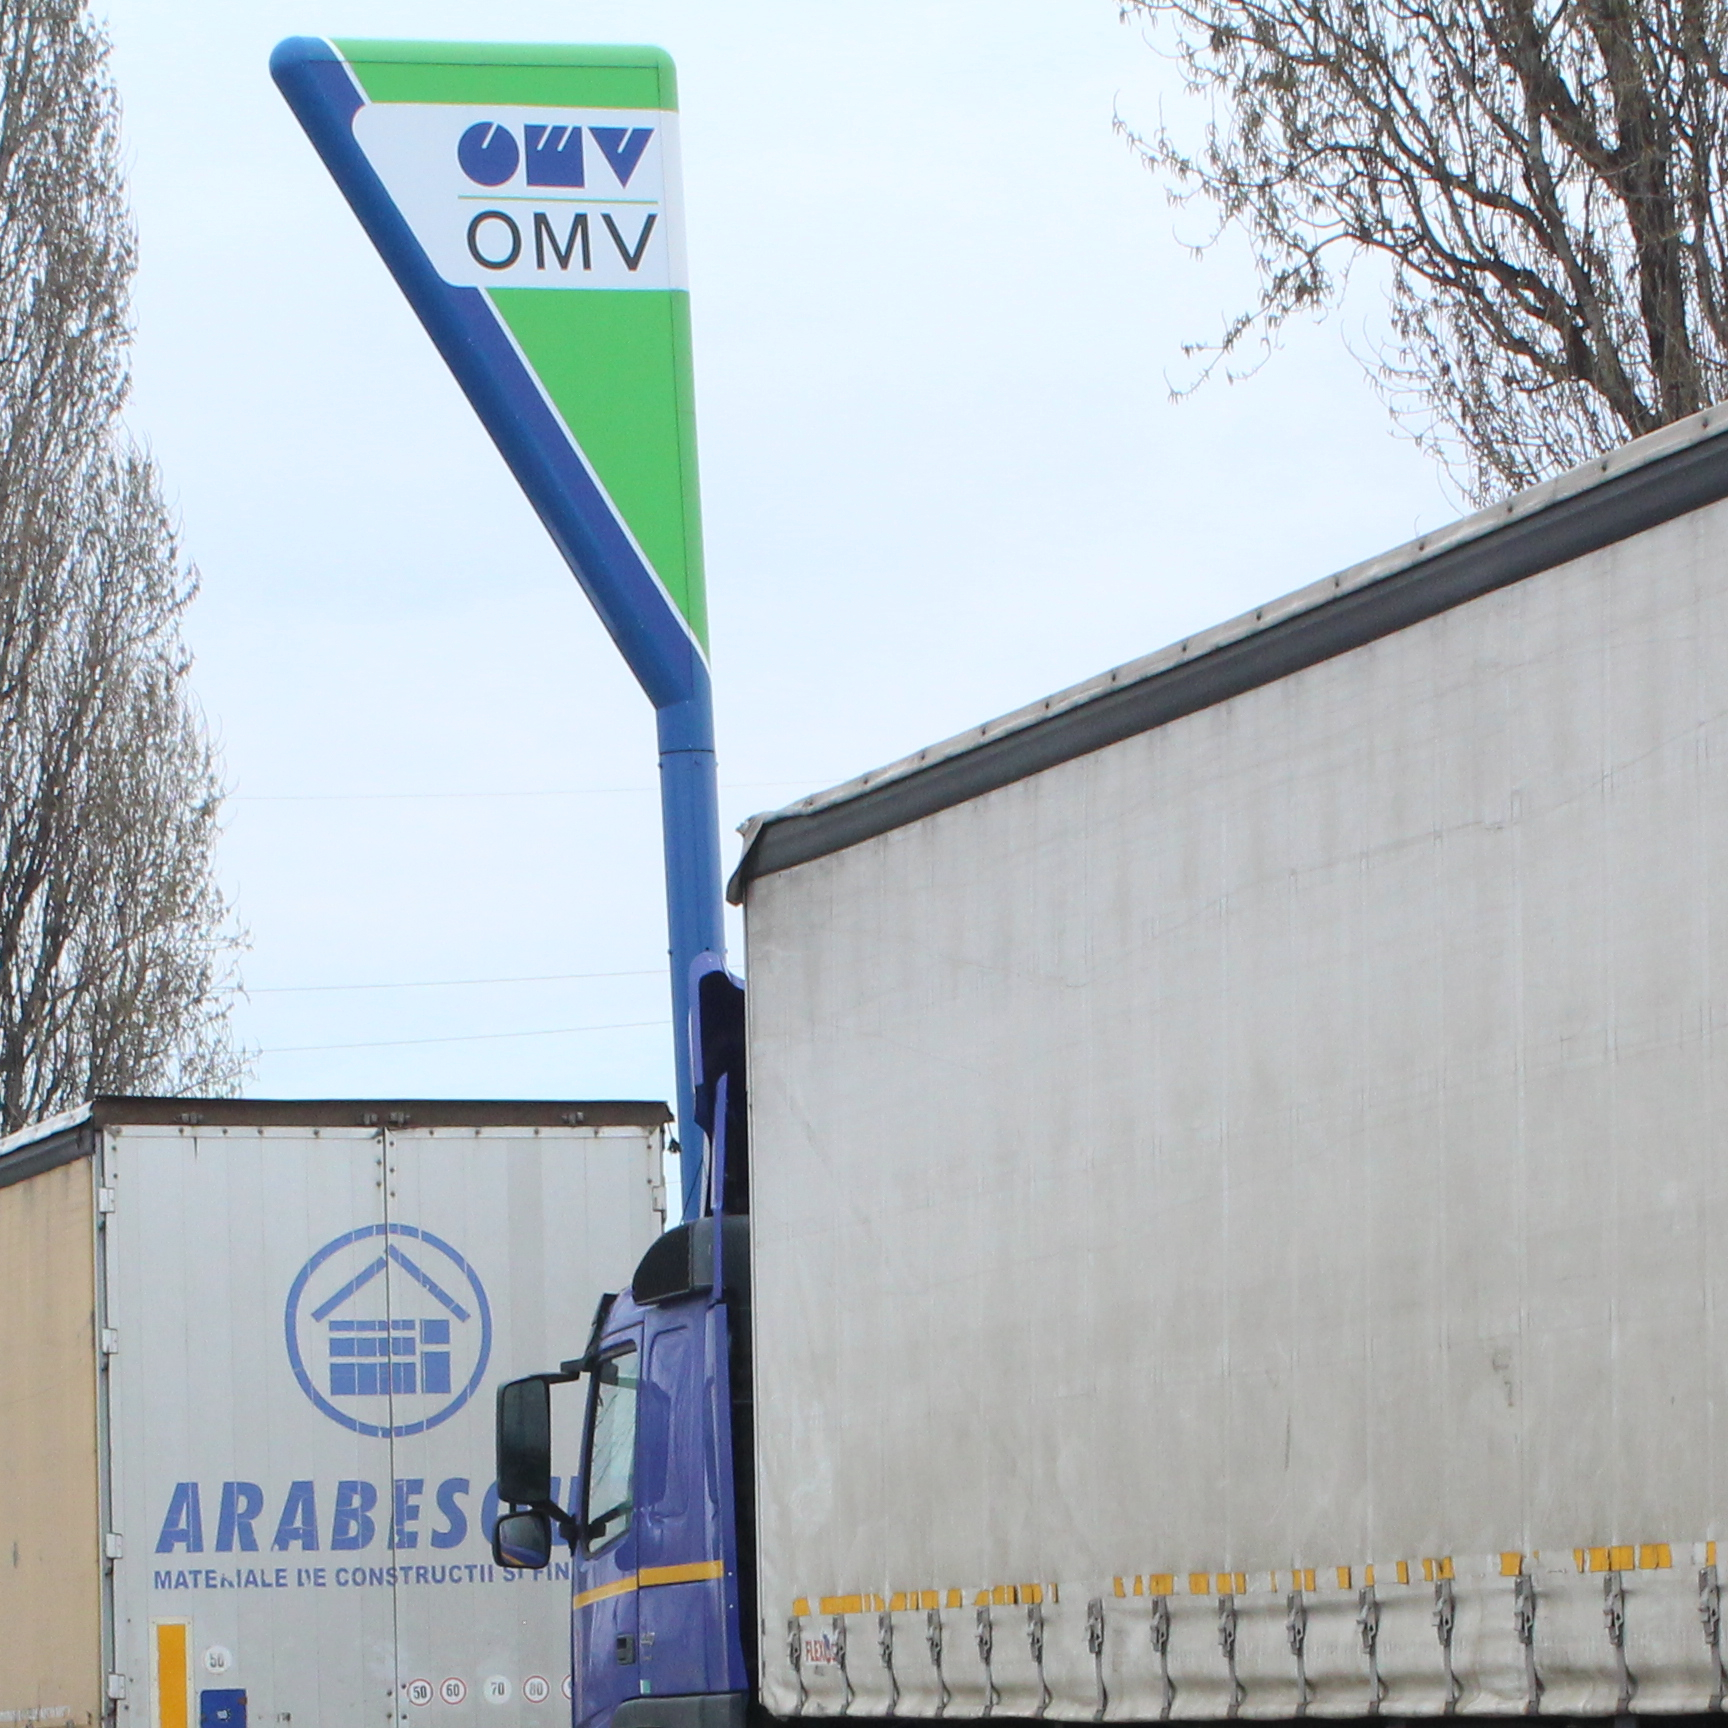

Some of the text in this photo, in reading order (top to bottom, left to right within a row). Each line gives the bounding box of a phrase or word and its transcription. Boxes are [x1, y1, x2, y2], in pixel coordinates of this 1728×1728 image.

[466, 210, 658, 271] OMV
[155, 1475, 579, 1553] ARABESU
[297, 1567, 327, 1588] DE
[335, 1563, 494, 1587] CONSTRUCTII
[533, 1561, 570, 1582] FIN
[413, 1685, 427, 1700] 50
[446, 1683, 460, 1697] 60
[490, 1681, 505, 1696] 70
